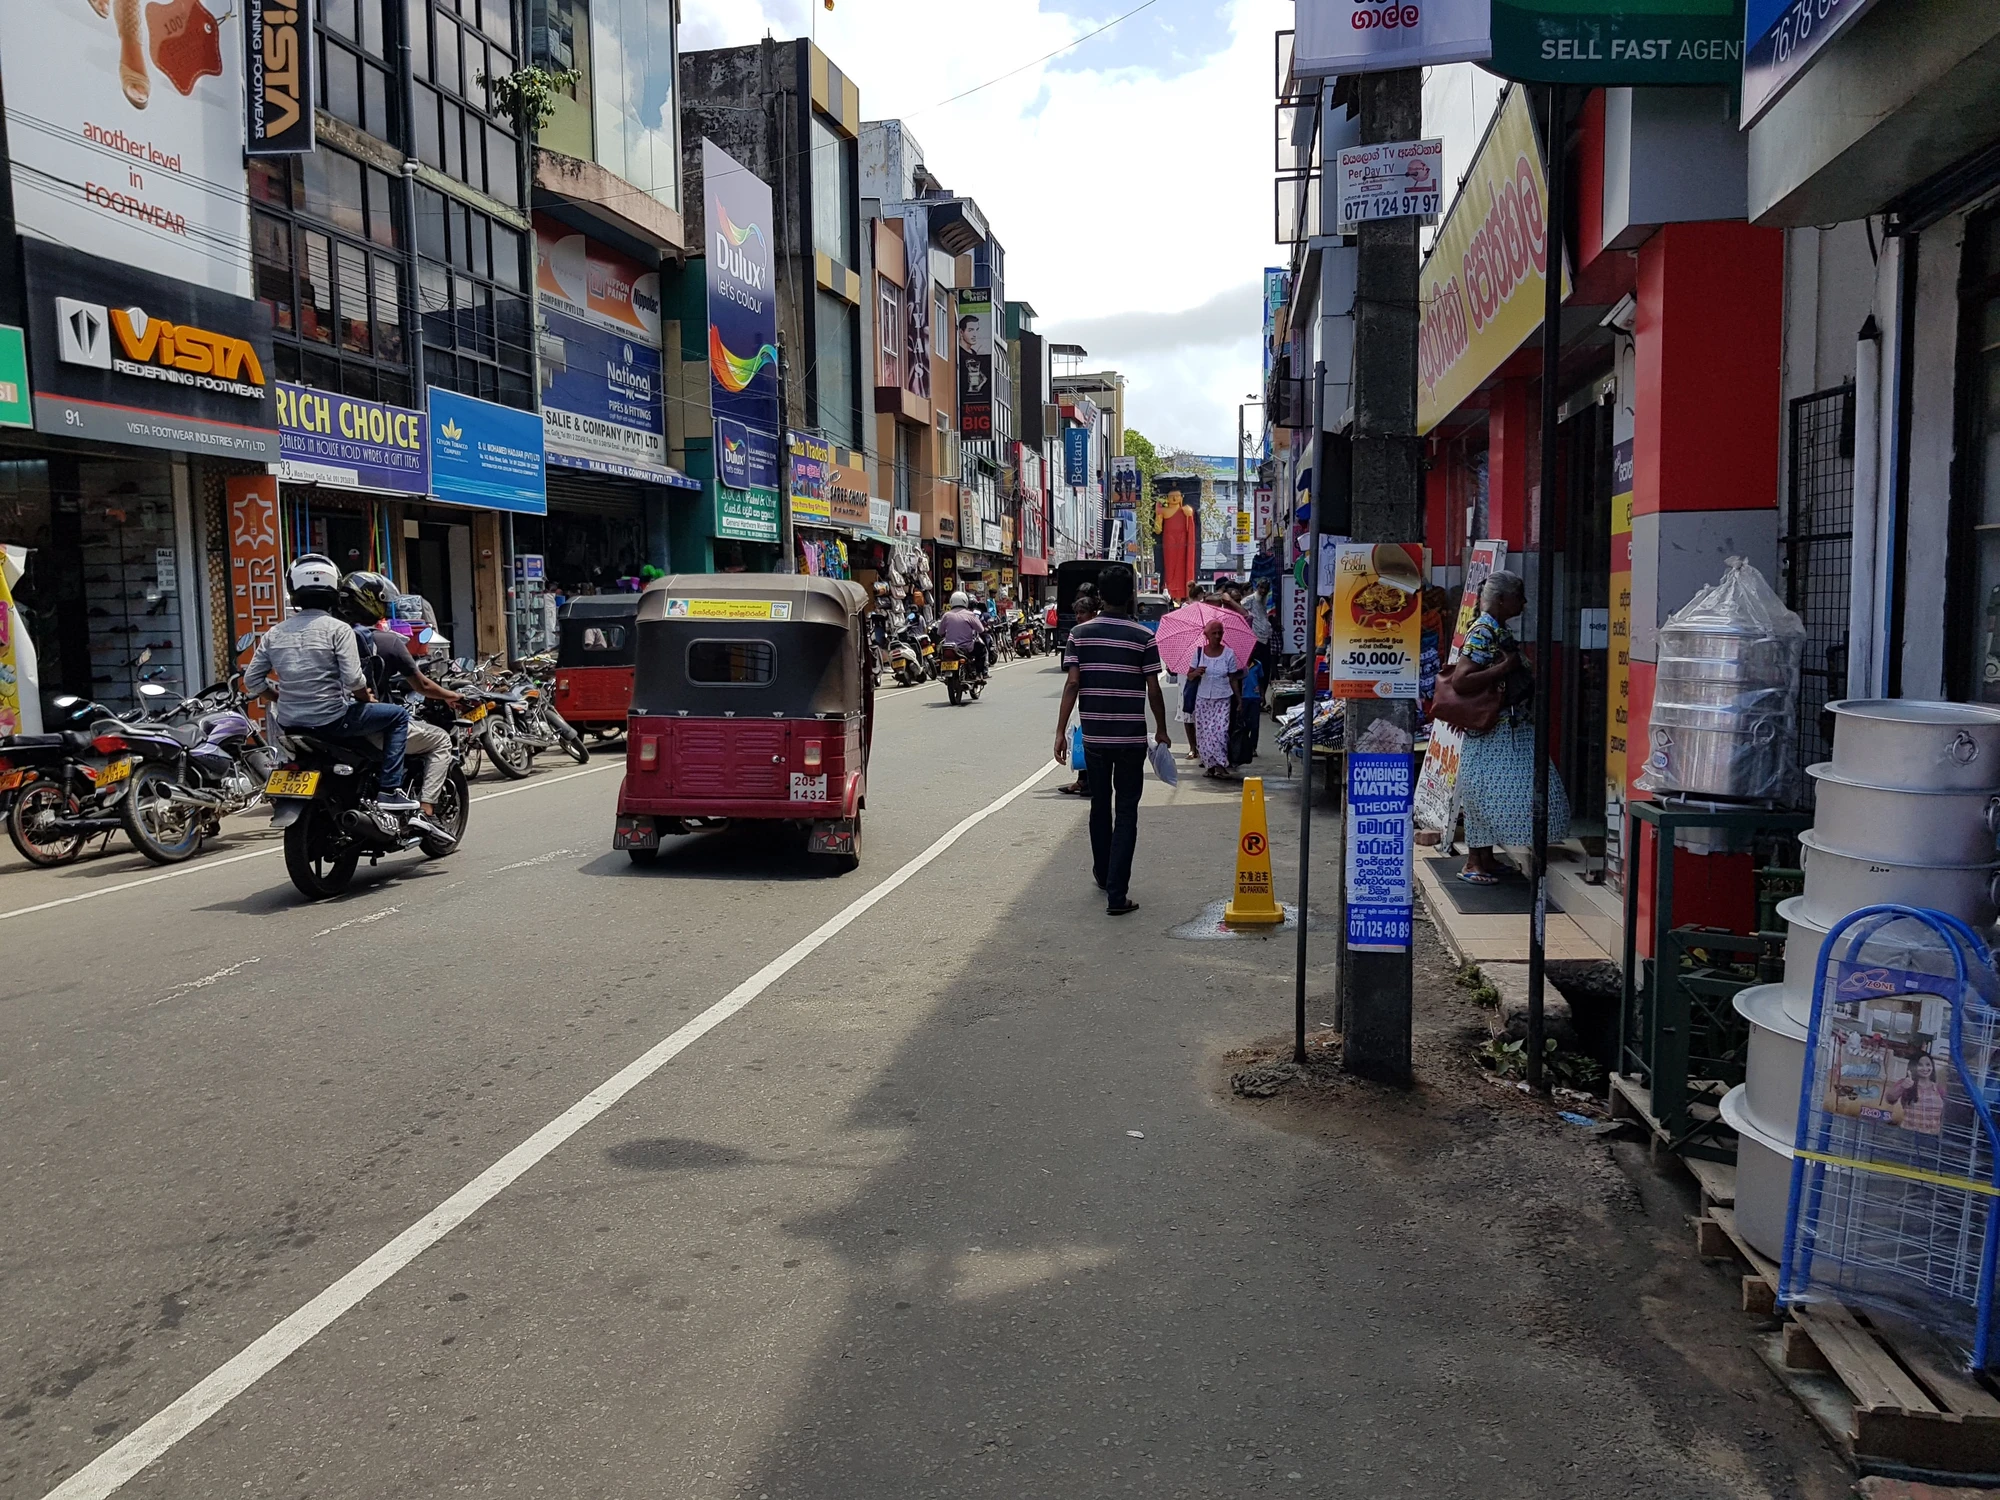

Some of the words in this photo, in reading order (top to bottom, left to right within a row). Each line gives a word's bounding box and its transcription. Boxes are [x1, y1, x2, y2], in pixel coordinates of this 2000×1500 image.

[1351, 5, 1419, 29] ගාල්ල
[1541, 39, 1602, 60] SELL
[1611, 40, 1671, 60] FAST
[253, 55, 264, 139] FOOTWEAR
[83, 121, 145, 159] another
[148, 142, 182, 173] level
[1382, 147, 1395, 159] Tv
[129, 167, 143, 190] in
[1348, 168, 1362, 180] Per
[1364, 165, 1380, 179] Day
[1383, 164, 1395, 174] TV
[85, 181, 186, 236] FOOTWEAR
[1345, 200, 1368, 220] 077
[1373, 197, 1398, 216] 124
[1402, 195, 1418, 214] 97
[1423, 194, 1439, 213] 97
[716, 230, 762, 291] Dulux
[540, 292, 563, 308] COMPANY
[607, 288, 627, 303] PAINT
[717, 273, 735, 300] let's
[736, 285, 763, 315] colour
[969, 292, 988, 302] MEN
[113, 359, 194, 385] REDEFINING
[196, 376, 265, 398] FOOTWEAR
[607, 361, 651, 391] National
[625, 389, 635, 400] PVC
[276, 390, 331, 435] RICH
[339, 402, 420, 450] CHOICE
[608, 400, 624, 413] PIPES
[624, 405, 629, 414] &
[629, 405, 652, 420] FITTINGS
[546, 410, 571, 430] SALIE
[575, 417, 581, 431] &
[583, 419, 622, 441] COMPANY
[623, 430, 644, 449] (PVT)
[645, 435, 659, 449] LTD
[962, 416, 990, 430] BIG
[127, 422, 150, 435] VISTA
[152, 426, 194, 441] FOOTWEAR
[195, 432, 232, 447] INDUSTRIES
[233, 438, 252, 452] (PVT)
[252, 441, 266, 452] LTD
[316, 440, 339, 457] HOUSE
[341, 445, 361, 460] HOLD
[363, 449, 382, 463] WARES
[725, 448, 744, 466] Dulux
[806, 440, 828, 462] Traders
[1072, 434, 1083, 483] Bettans
[608, 465, 624, 475] SALIE
[628, 468, 652, 480] COMPANY
[664, 474, 673, 484] LTD
[1293, 589, 1307, 651] PHARMACY
[270, 778, 282, 786] SP
[1353, 768, 1409, 782] COMBINED
[281, 783, 308, 794] 3427
[793, 790, 825, 800] 1432
[1353, 782, 1409, 797] MATHS
[1357, 801, 1406, 814] THEORY
[1239, 871, 1269, 882] 不准泊车
[1239, 886, 1247, 894] NO
[1247, 886, 1269, 894] PARKING
[1350, 921, 1365, 938] 071
[1367, 922, 1382, 938] 125
[1384, 922, 1397, 938] 49
[1399, 922, 1410, 938] 89
